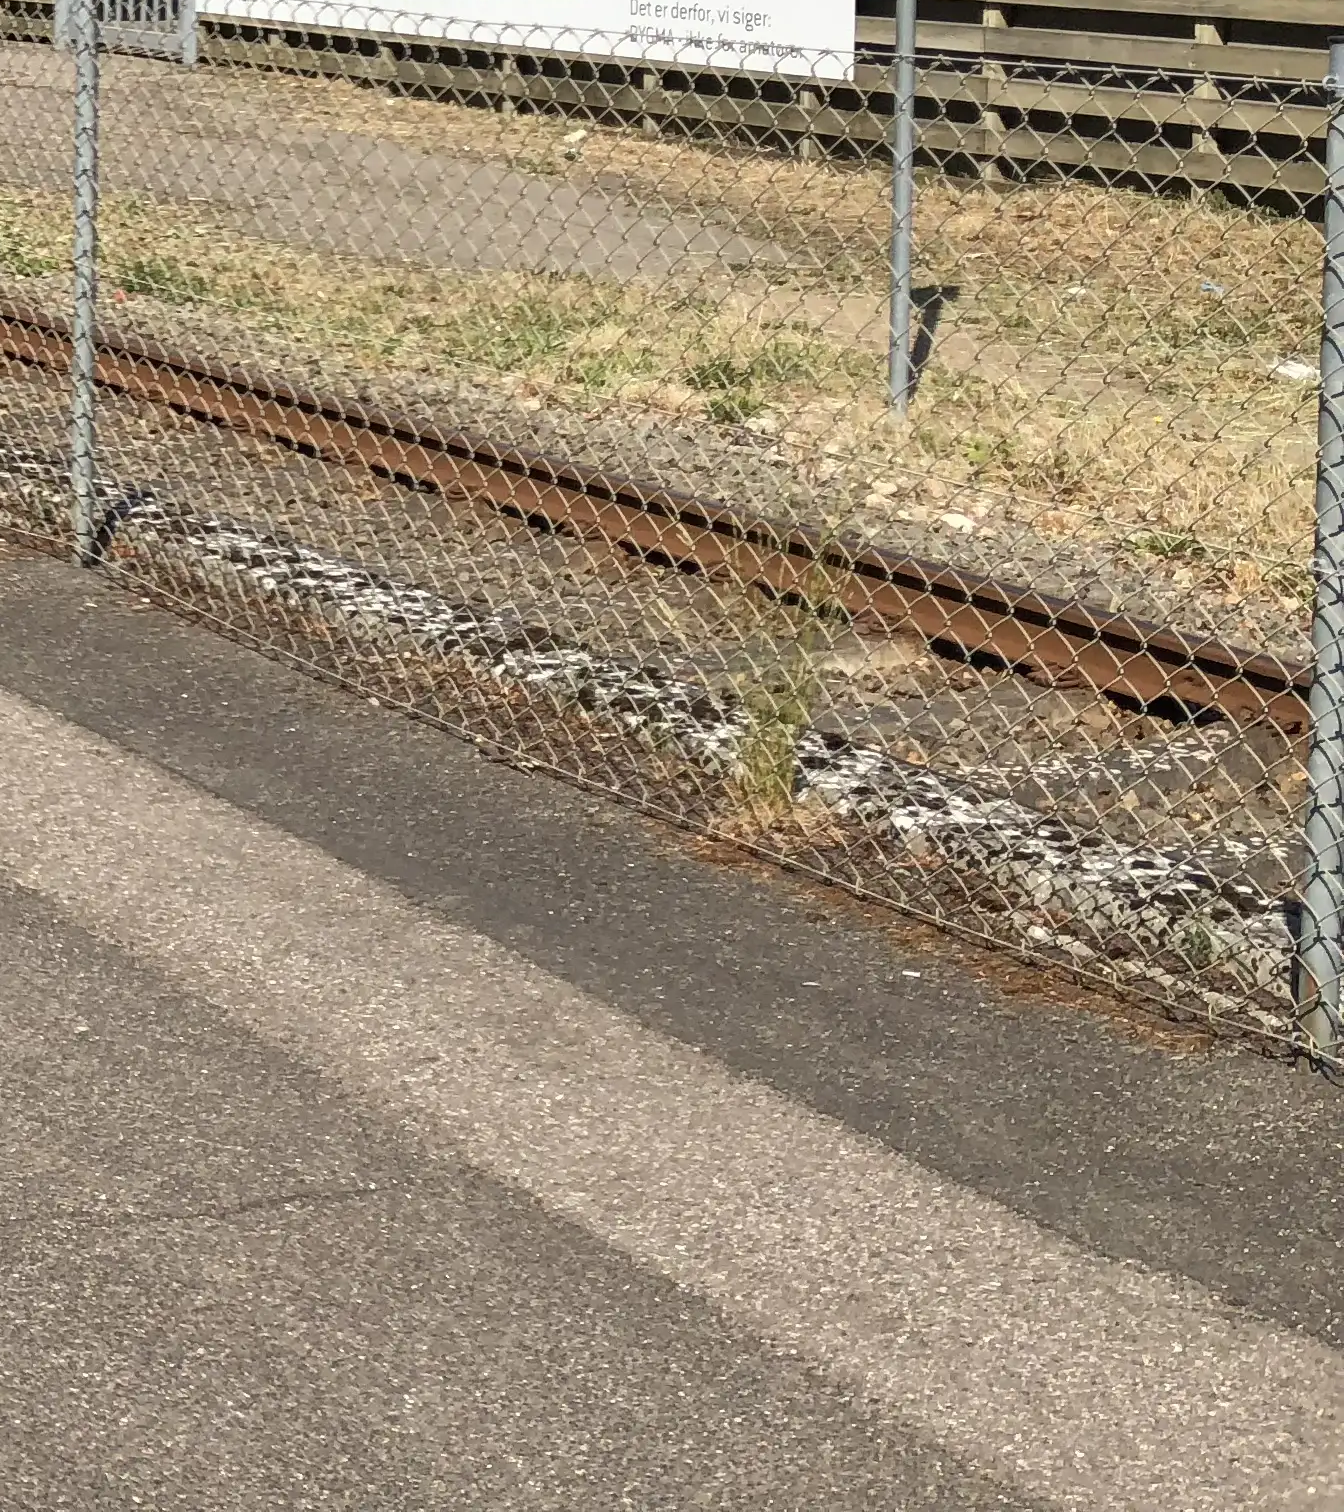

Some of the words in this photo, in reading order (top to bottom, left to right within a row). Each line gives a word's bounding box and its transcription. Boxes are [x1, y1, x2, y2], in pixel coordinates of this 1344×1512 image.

[654, 4, 669, 18] er
[671, 1, 716, 25] derfor,
[717, 5, 730, 24] vi
[732, 7, 772, 32] siger:
